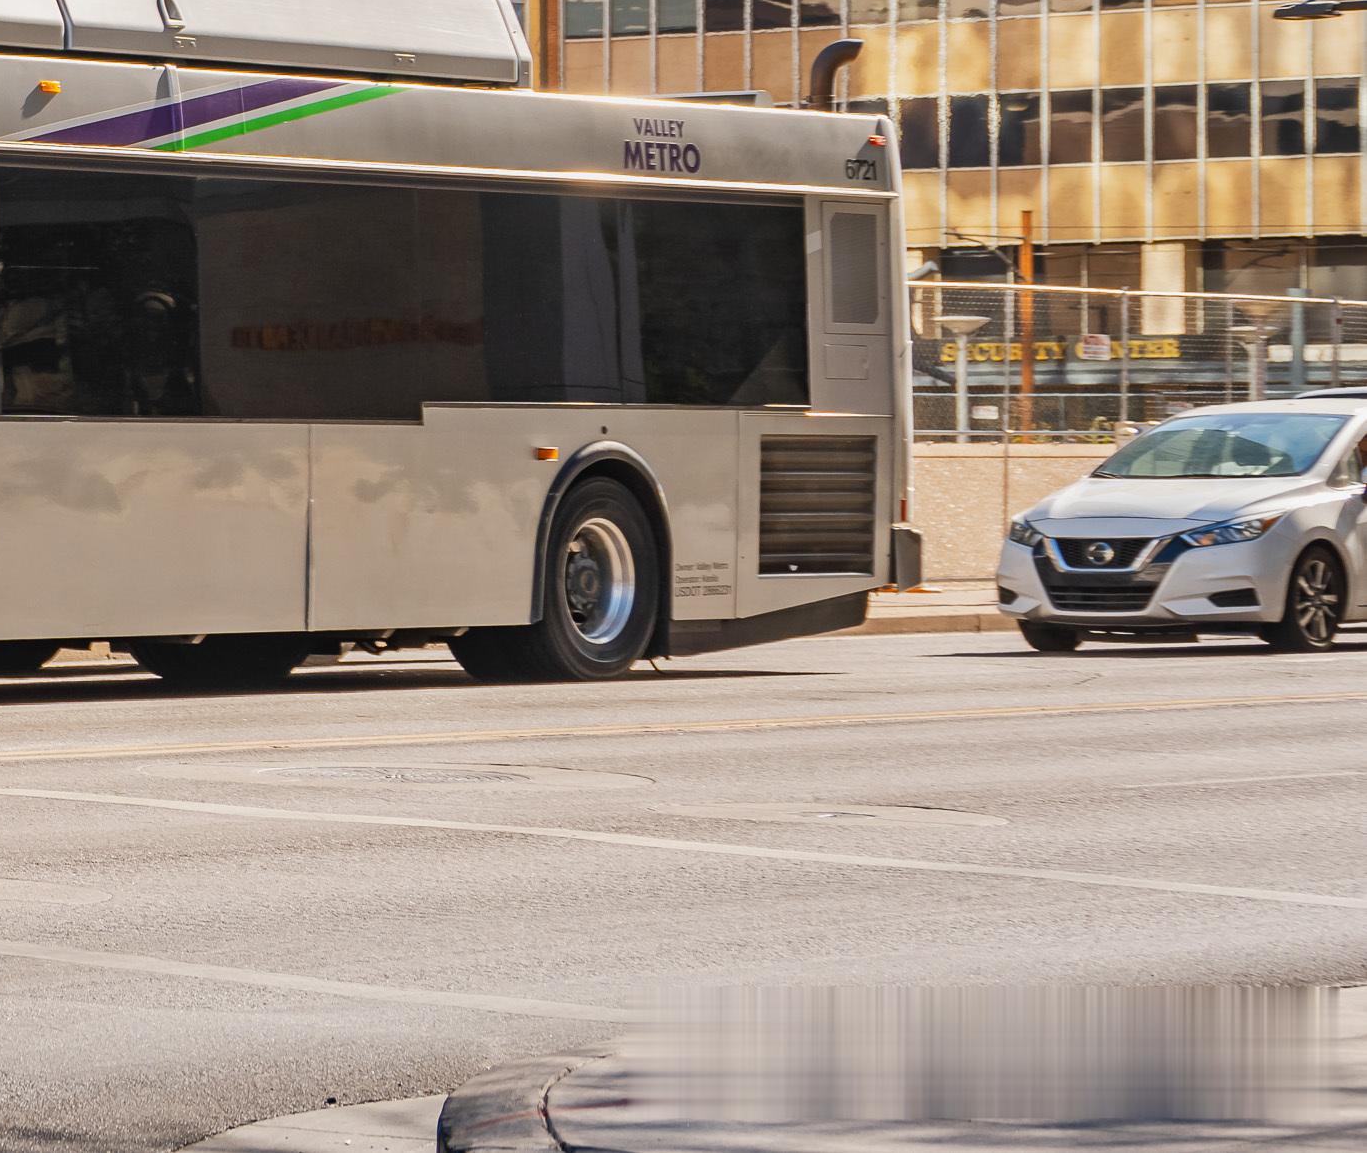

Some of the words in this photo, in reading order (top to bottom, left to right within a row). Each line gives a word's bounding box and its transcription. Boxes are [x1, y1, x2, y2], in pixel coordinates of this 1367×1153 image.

[633, 117, 685, 138] VALLEY
[624, 140, 701, 173] METRO
[845, 158, 877, 181] 6721
